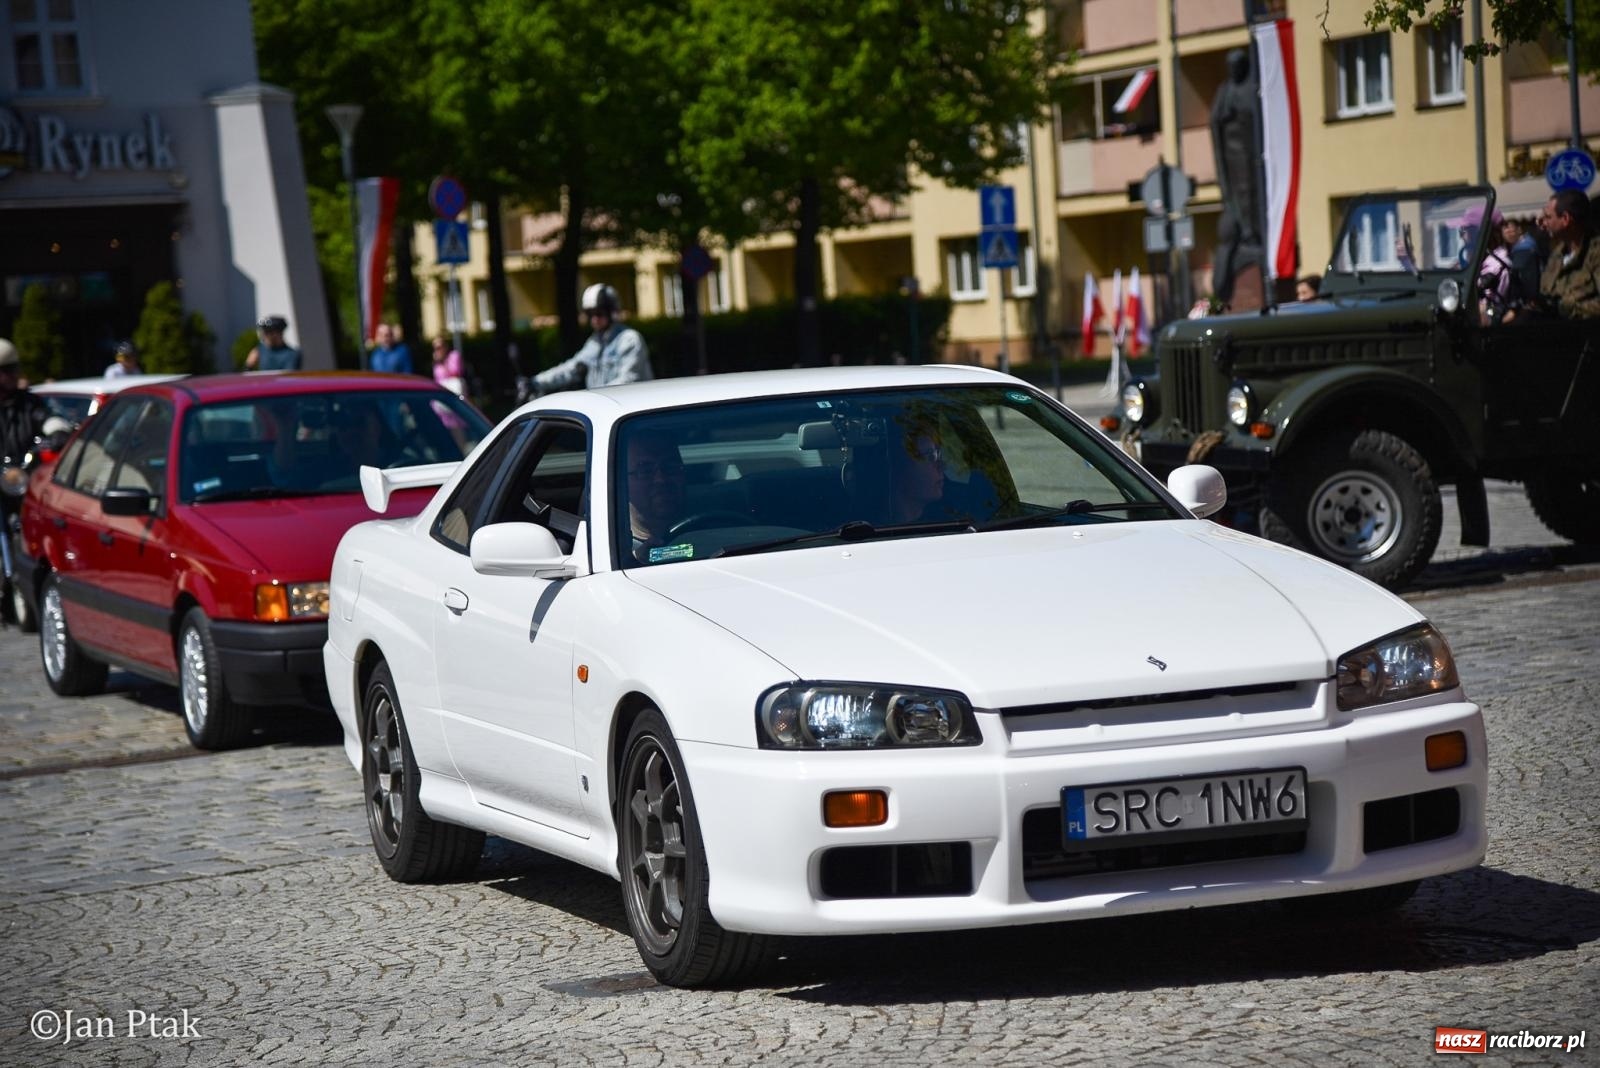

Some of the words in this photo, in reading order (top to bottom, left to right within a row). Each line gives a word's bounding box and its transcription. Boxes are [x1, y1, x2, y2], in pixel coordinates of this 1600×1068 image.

[38, 112, 176, 180] Rynek
[1069, 821, 1084, 833] PL
[1093, 786, 1183, 834] SRC
[1198, 774, 1297, 825] 1NW6
